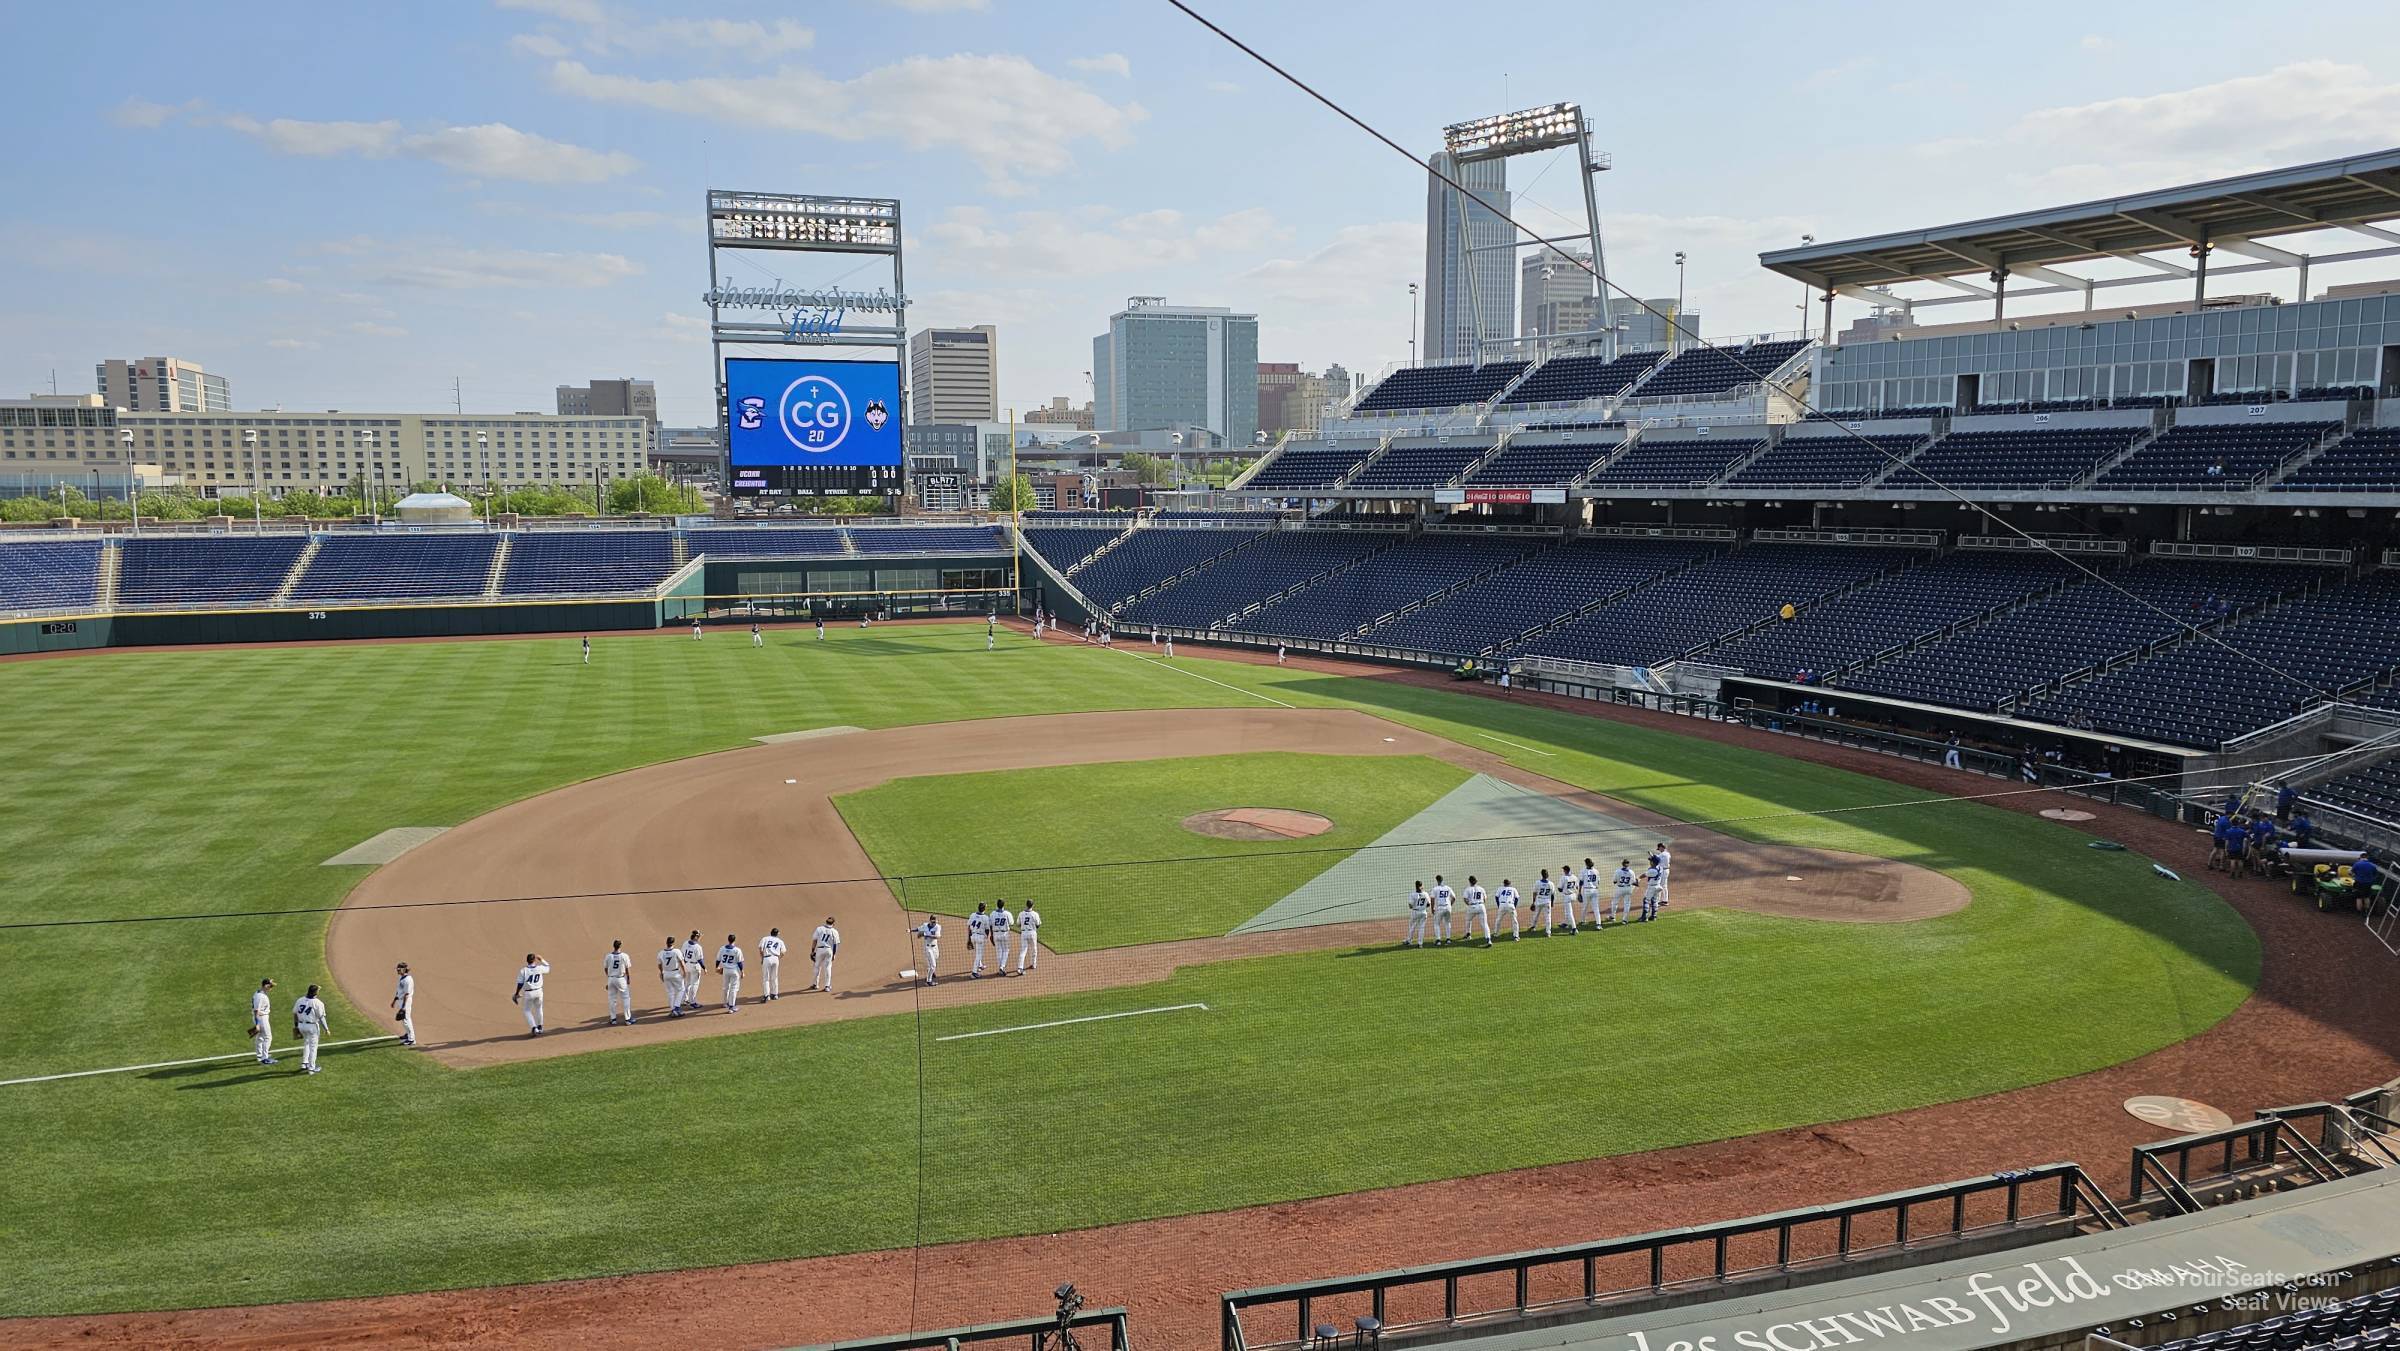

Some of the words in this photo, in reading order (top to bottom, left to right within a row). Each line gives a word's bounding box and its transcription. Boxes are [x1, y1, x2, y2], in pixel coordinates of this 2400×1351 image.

[707, 277, 806, 307] charles
[811, 289, 908, 309] SCHWAB
[784, 308, 845, 340] field
[795, 335, 838, 344] OMAHA
[792, 401, 839, 428] CG
[808, 430, 825, 442] 20
[930, 476, 955, 485] BLATT
[308, 611, 326, 619] 375
[50, 623, 75, 634] 0:20
[971, 920, 982, 929] 44
[994, 917, 1006, 926] 28
[1023, 916, 1030, 926] 2
[821, 933, 830, 942] 11
[766, 940, 778, 950] 24
[665, 956, 672, 966] 7
[722, 954, 735, 964] 32
[613, 960, 620, 969] 5
[526, 973, 540, 984] 40
[298, 1004, 312, 1016] 34
[1733, 1297, 1976, 1351] SCHWAB
[1966, 1257, 2111, 1334] field
[2112, 1255, 2247, 1290] OMAHA
